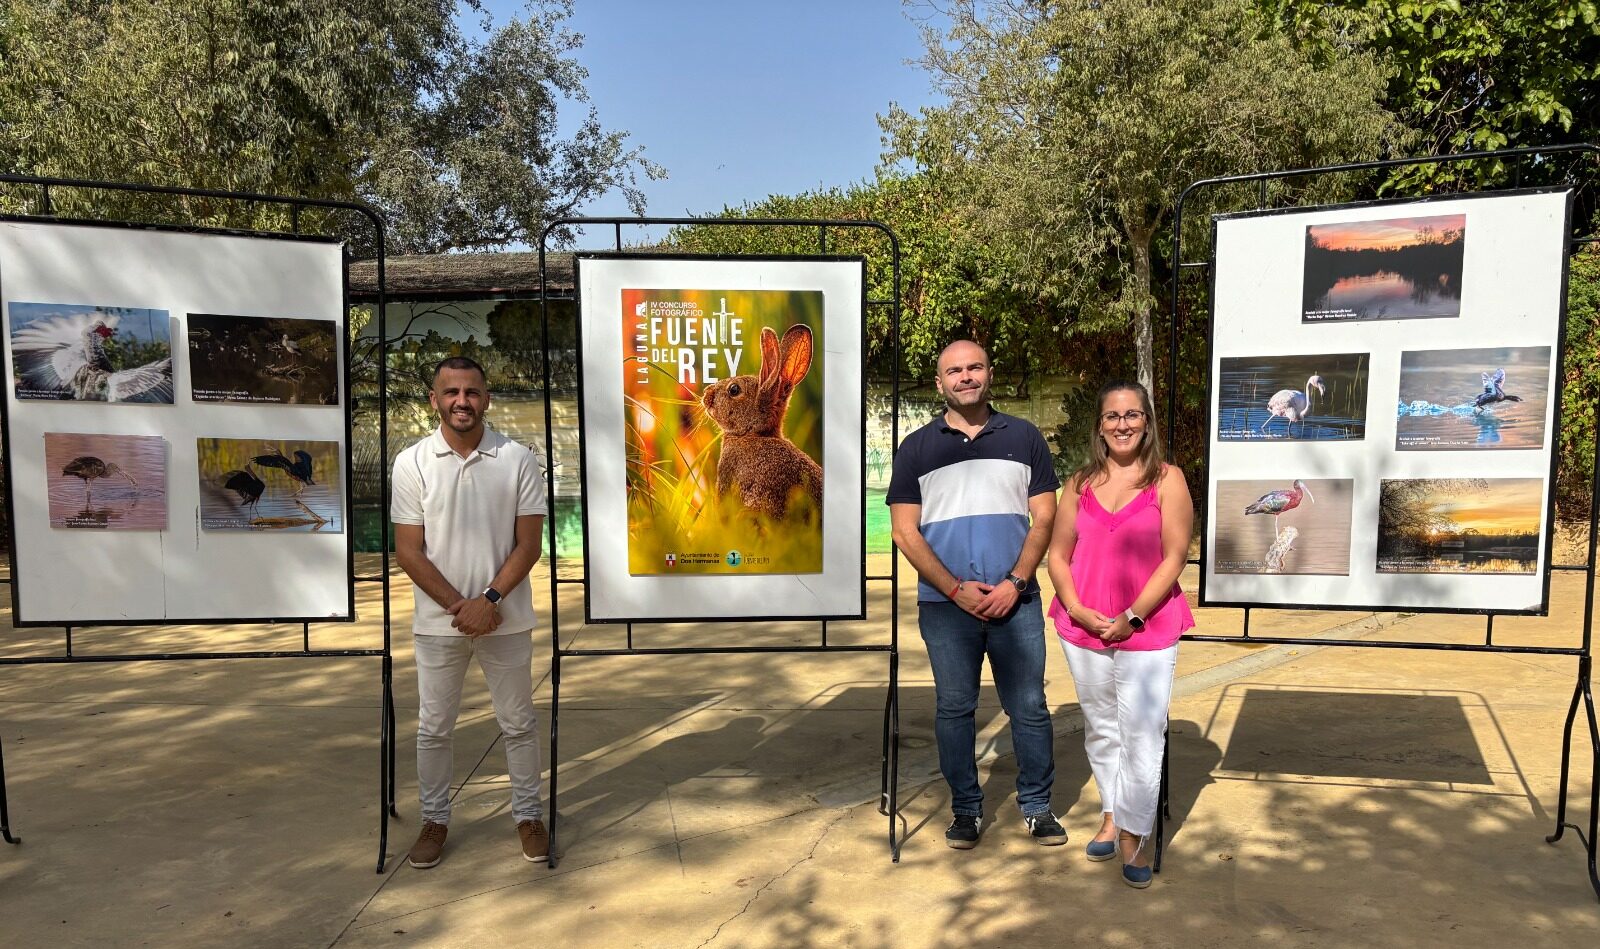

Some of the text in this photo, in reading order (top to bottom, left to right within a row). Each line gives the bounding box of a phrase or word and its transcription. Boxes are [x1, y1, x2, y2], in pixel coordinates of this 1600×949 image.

[650, 301, 698, 309] IV CONCURSO
[650, 308, 704, 316] FOTOGRÁFICO
[636, 322, 649, 384] LAGUNA
[652, 347, 743, 384] DEL REY
